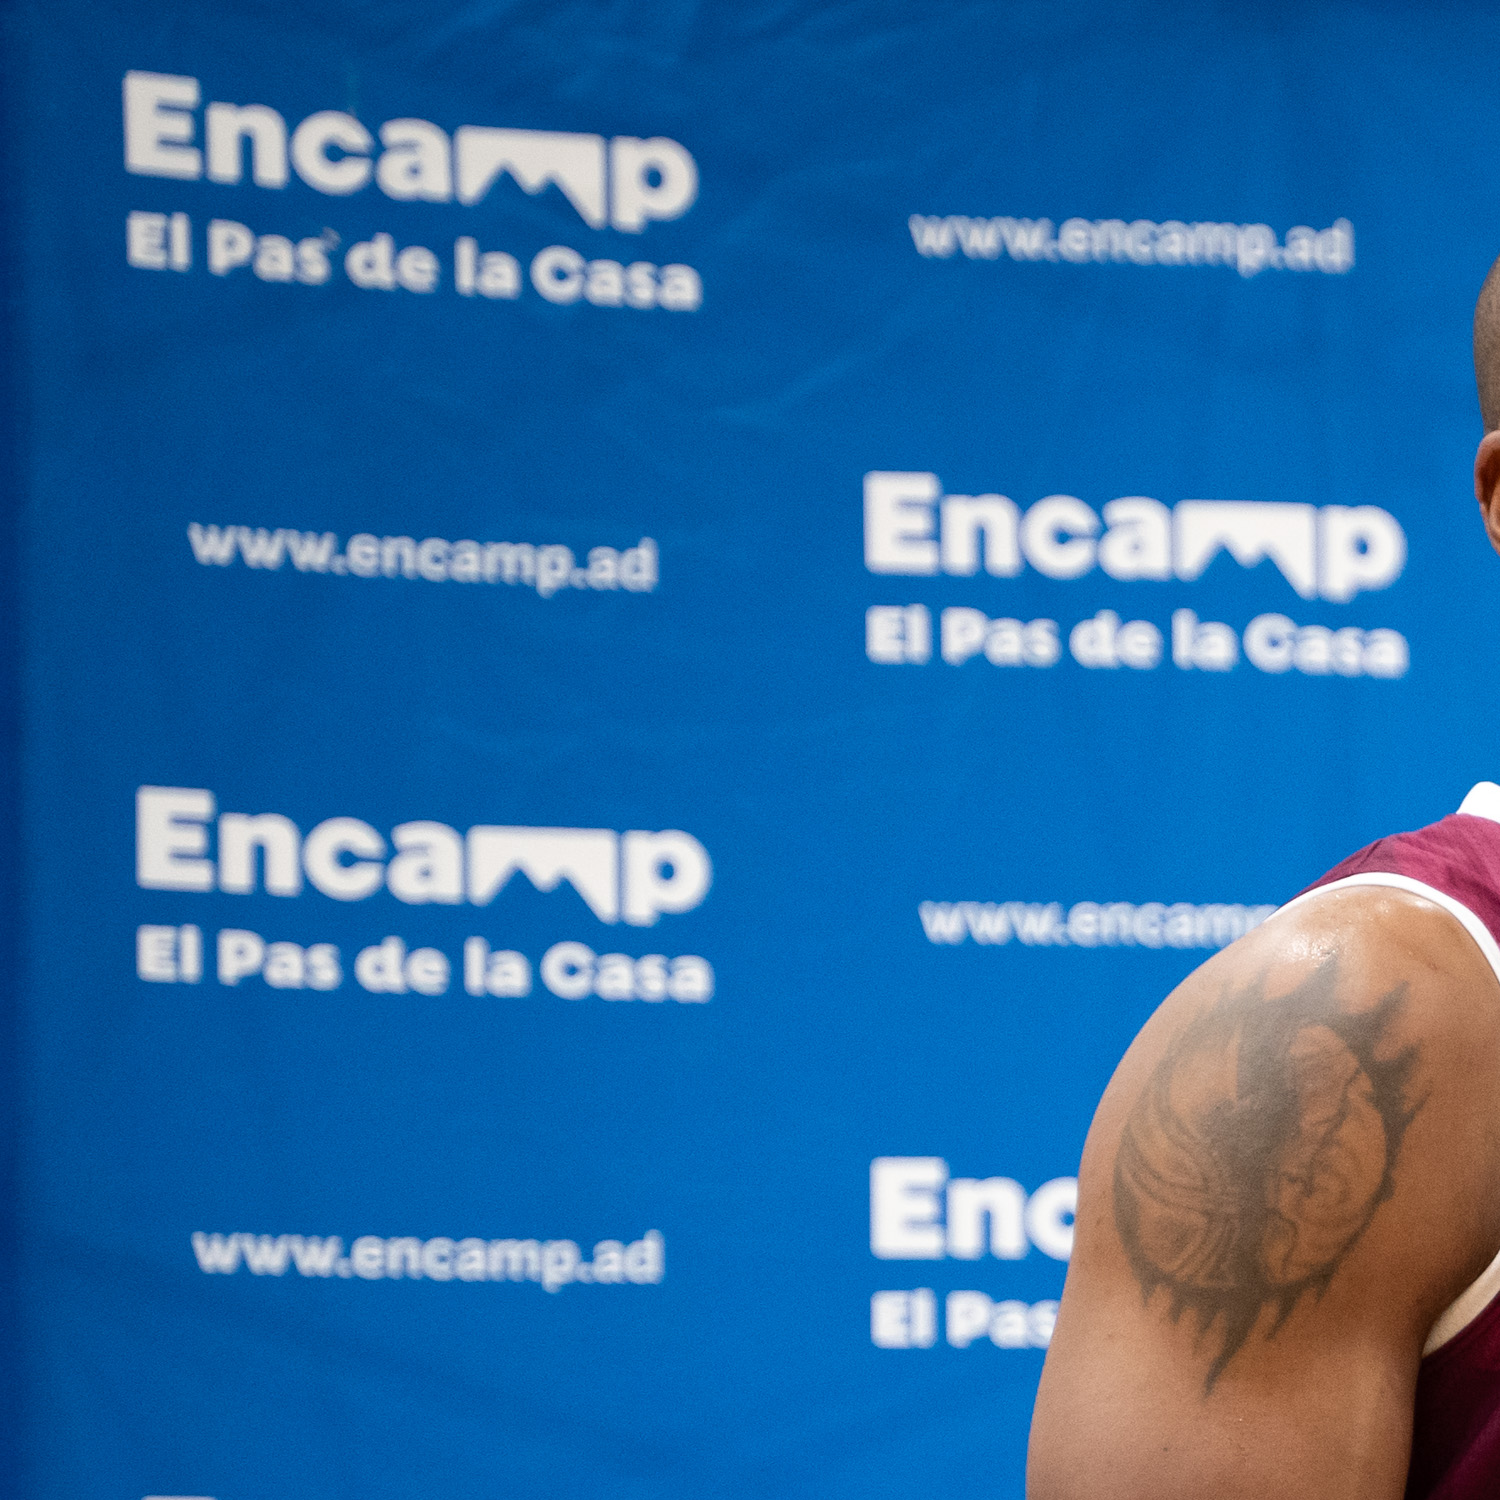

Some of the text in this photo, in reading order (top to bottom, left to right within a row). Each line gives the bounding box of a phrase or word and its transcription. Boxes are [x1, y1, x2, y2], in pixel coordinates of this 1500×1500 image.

[123, 71, 697, 232] Encamp
[127, 212, 701, 310] El Pas de la Casa
[910, 216, 1353, 275] www.encamp.ad
[189, 524, 657, 595] www.encamp.ad
[863, 471, 1406, 600] Encamp
[866, 604, 1409, 678] El Pas de la Casa
[136, 786, 711, 926] Encamp
[917, 901, 1278, 948] www.encam
[137, 924, 713, 1002] El Pas de la Casa
[870, 1156, 1078, 1261] Enc
[193, 1230, 664, 1292] www.encamp.ad
[871, 1287, 937, 1349] El
